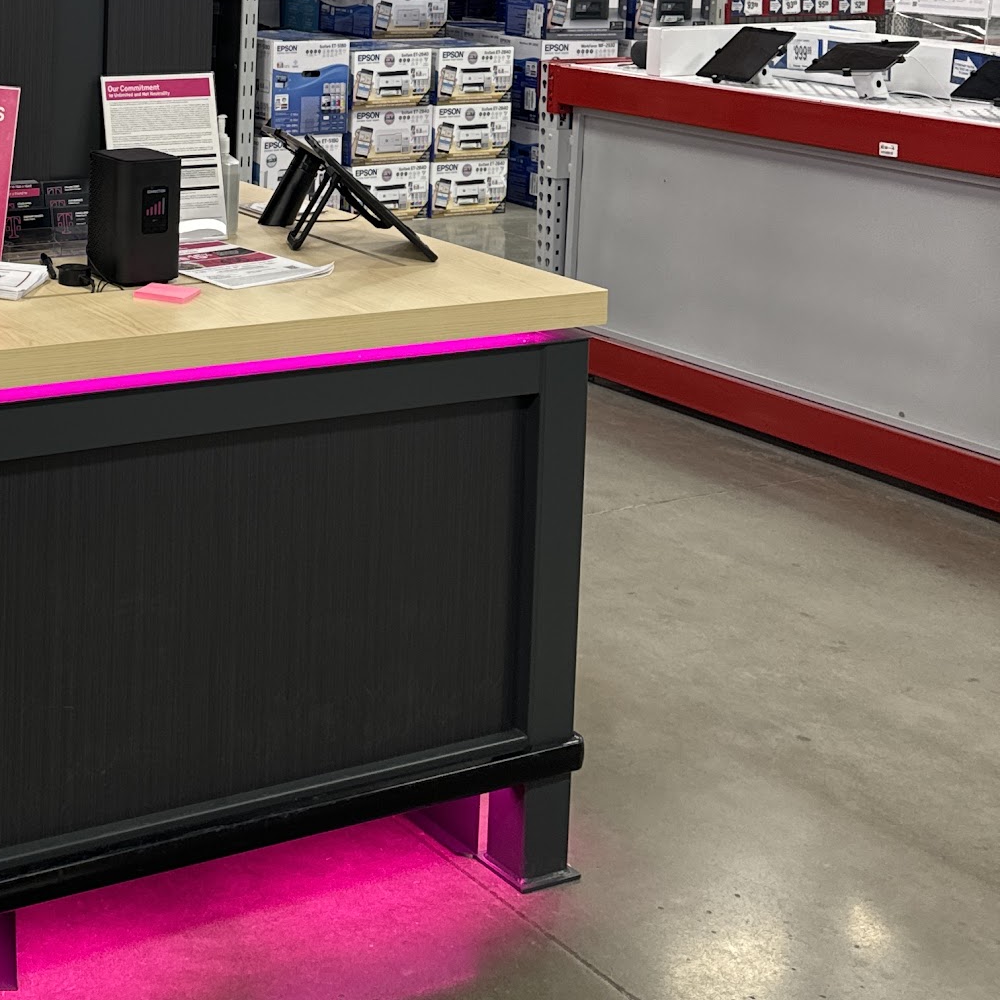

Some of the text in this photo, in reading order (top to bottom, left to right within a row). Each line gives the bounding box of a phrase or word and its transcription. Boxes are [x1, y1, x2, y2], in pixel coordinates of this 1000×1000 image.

[277, 44, 298, 52] EPSON
[544, 43, 569, 51] EPSON
[358, 54, 380, 62] EPSON
[442, 51, 464, 59] EPSON
[119, 84, 160, 92] Commitment
[357, 111, 380, 120] EPSON
[439, 108, 461, 116] EPSON
[264, 141, 286, 150] EPSO
[436, 164, 458, 172] EPSON
[355, 168, 377, 177] EPSON
